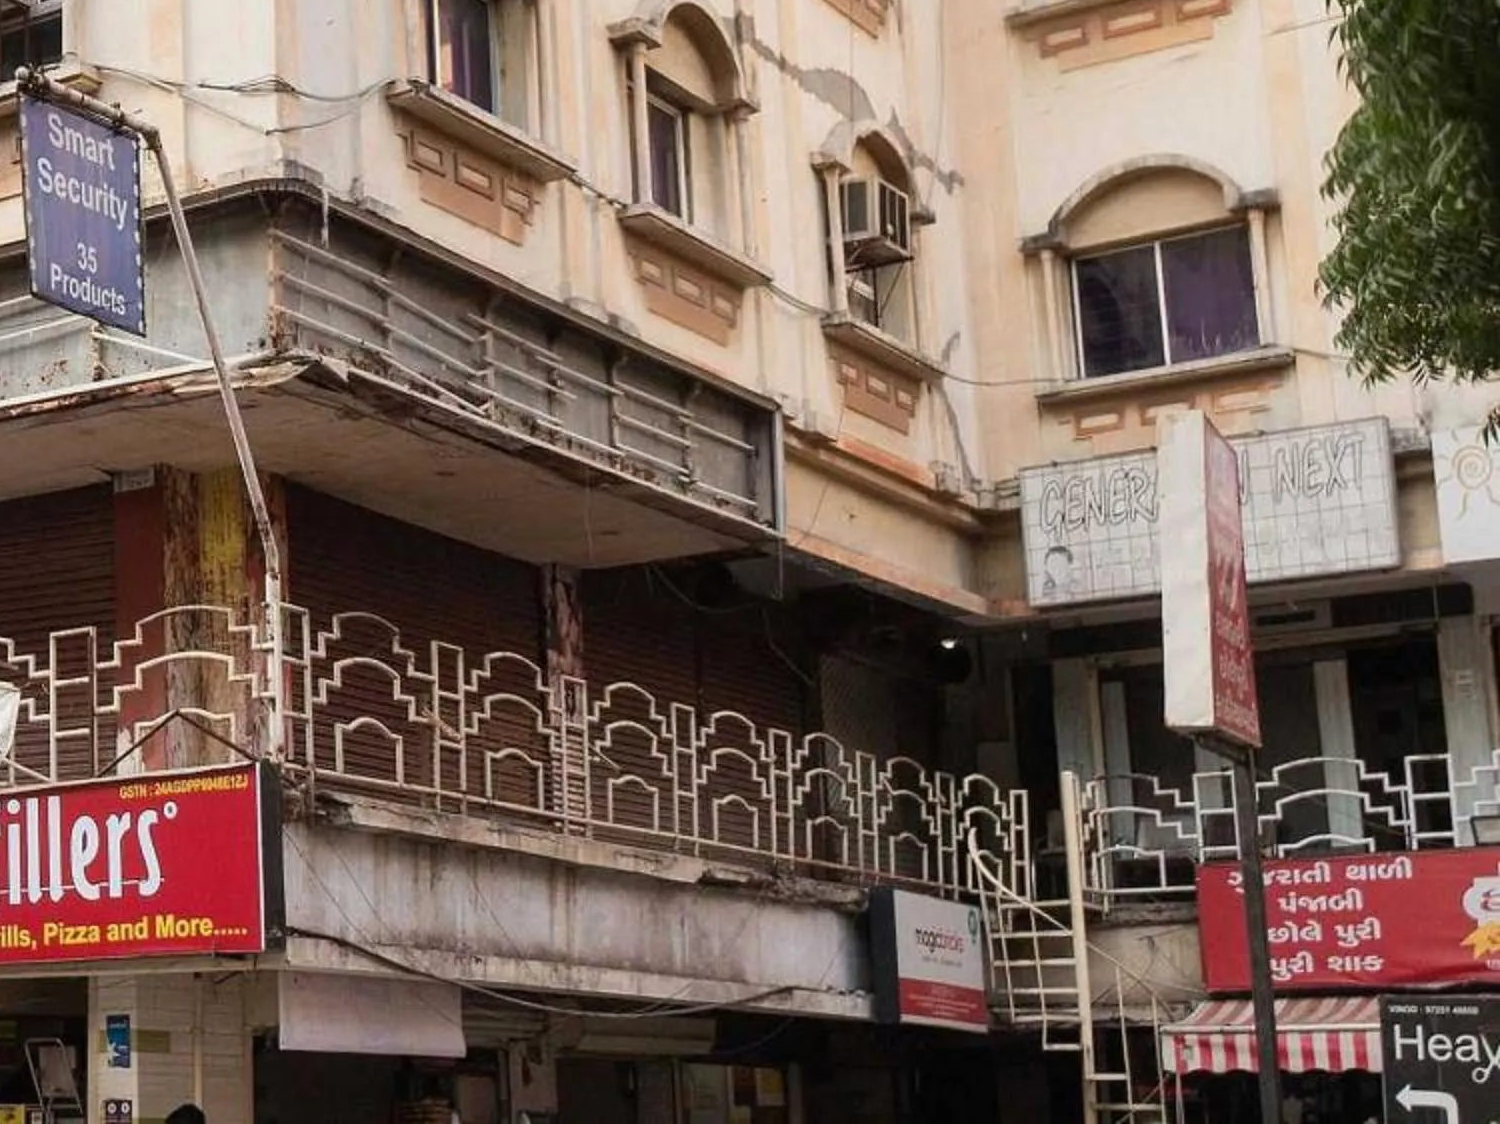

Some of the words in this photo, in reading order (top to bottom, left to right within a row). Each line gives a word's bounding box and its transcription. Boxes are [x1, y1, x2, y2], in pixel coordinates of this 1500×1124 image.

[48, 113, 116, 170] Smart
[37, 157, 129, 232] Security
[77, 241, 99, 274] 35
[50, 262, 126, 316] Products
[1271, 432, 1367, 506] NEXT
[43, 921, 100, 946] Pizza
[105, 916, 150, 942] and
